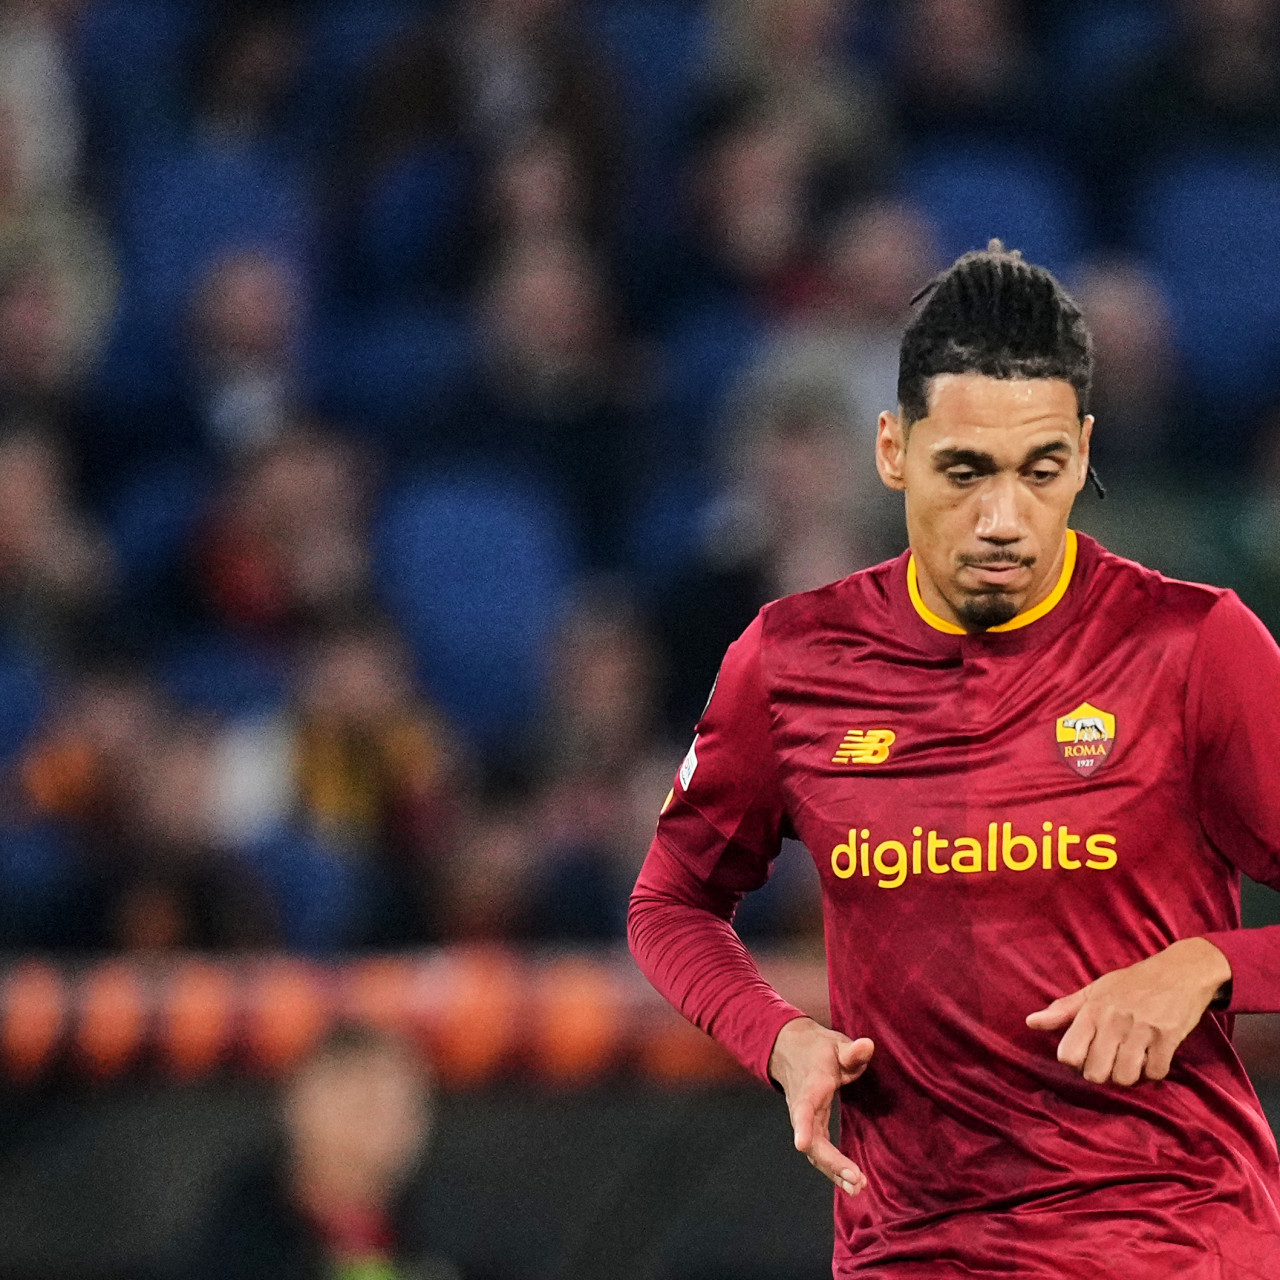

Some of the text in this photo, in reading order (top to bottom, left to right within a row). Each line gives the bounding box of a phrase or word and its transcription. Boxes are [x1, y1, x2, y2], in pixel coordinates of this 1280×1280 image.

[1064, 744, 1107, 758] ROMA
[1077, 759, 1095, 768] 1927
[831, 821, 1118, 889] digitalbits
